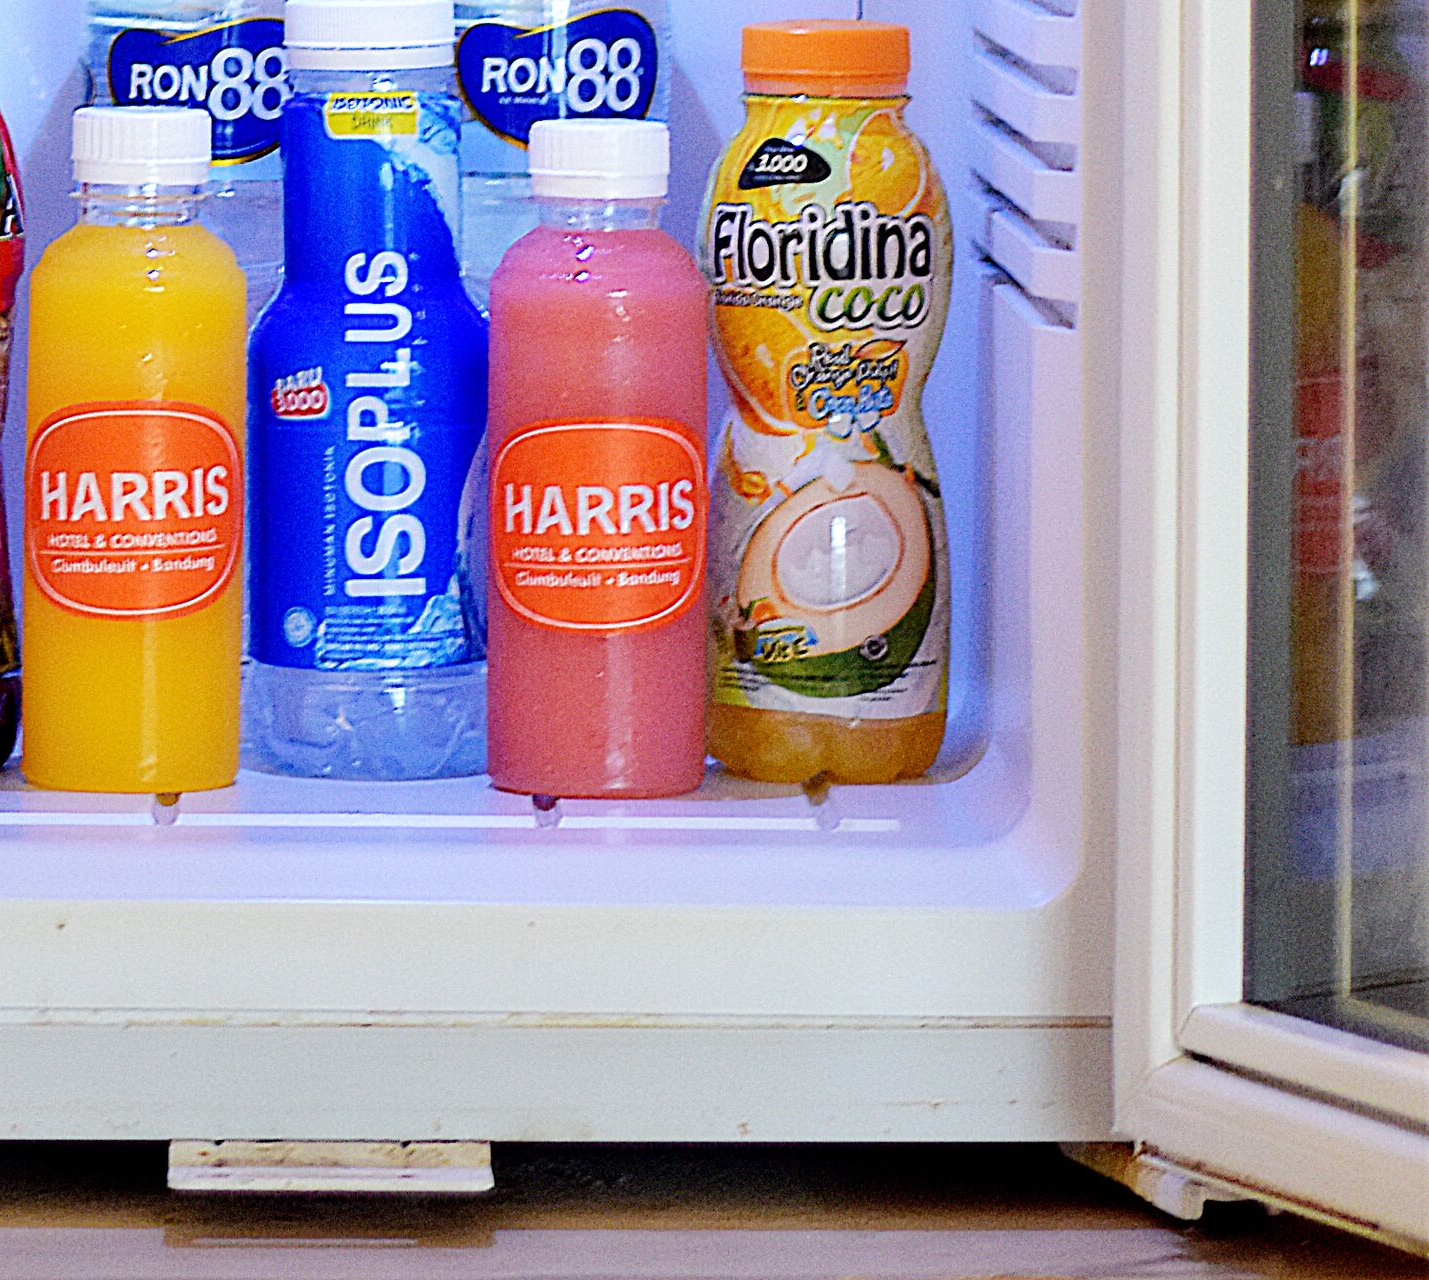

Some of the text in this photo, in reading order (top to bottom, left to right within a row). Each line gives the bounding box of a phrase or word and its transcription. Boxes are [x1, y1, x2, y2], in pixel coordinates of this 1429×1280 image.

[333, 96, 414, 110] ISOTONIC
[713, 204, 933, 284] Floridina
[344, 250, 427, 599] ISOPLUS
[40, 464, 230, 522] HARRIS
[503, 479, 696, 536] HARRIS
[49, 528, 218, 549] HOTEL & CONVENTIONS
[511, 542, 683, 563] HOTEL & CONVENTIONS
[151, 555, 215, 572] Bandung
[616, 569, 681, 587] Bandung
